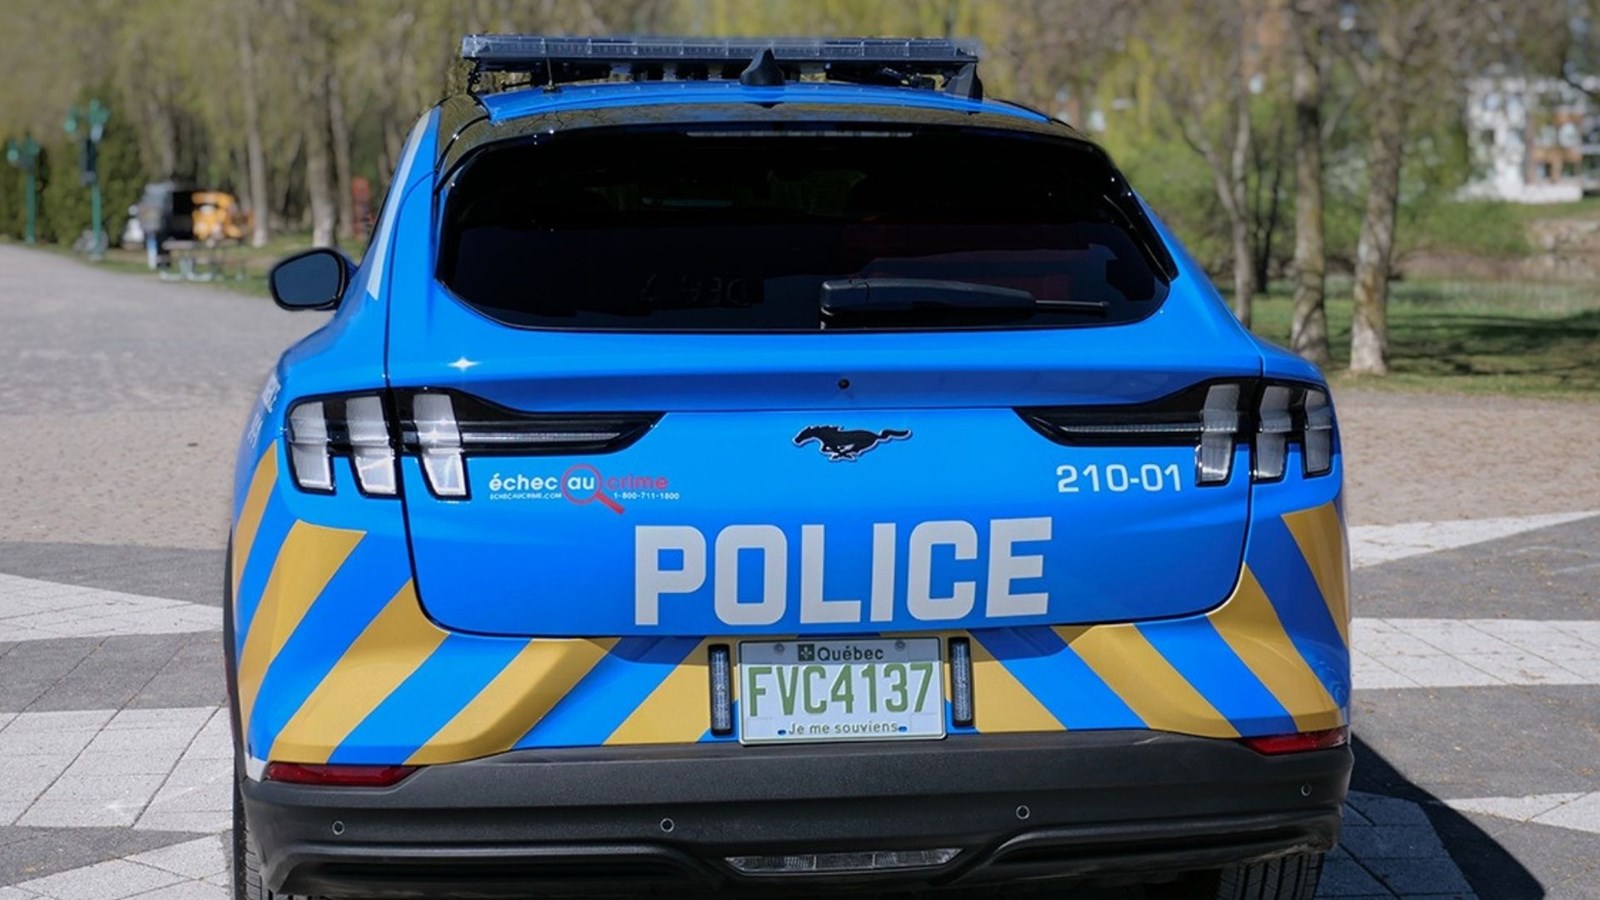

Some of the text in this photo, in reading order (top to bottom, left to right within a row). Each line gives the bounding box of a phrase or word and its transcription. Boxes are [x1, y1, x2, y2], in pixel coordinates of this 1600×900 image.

[489, 473, 668, 491] échec au crime
[1056, 464, 1181, 492] 210-01
[613, 491, 680, 500] 1-800-711-1800
[635, 516, 1052, 625] POLICE
[817, 644, 883, 661] Québec
[748, 662, 934, 716] FVC4137
[788, 721, 898, 735] Je me souviens
